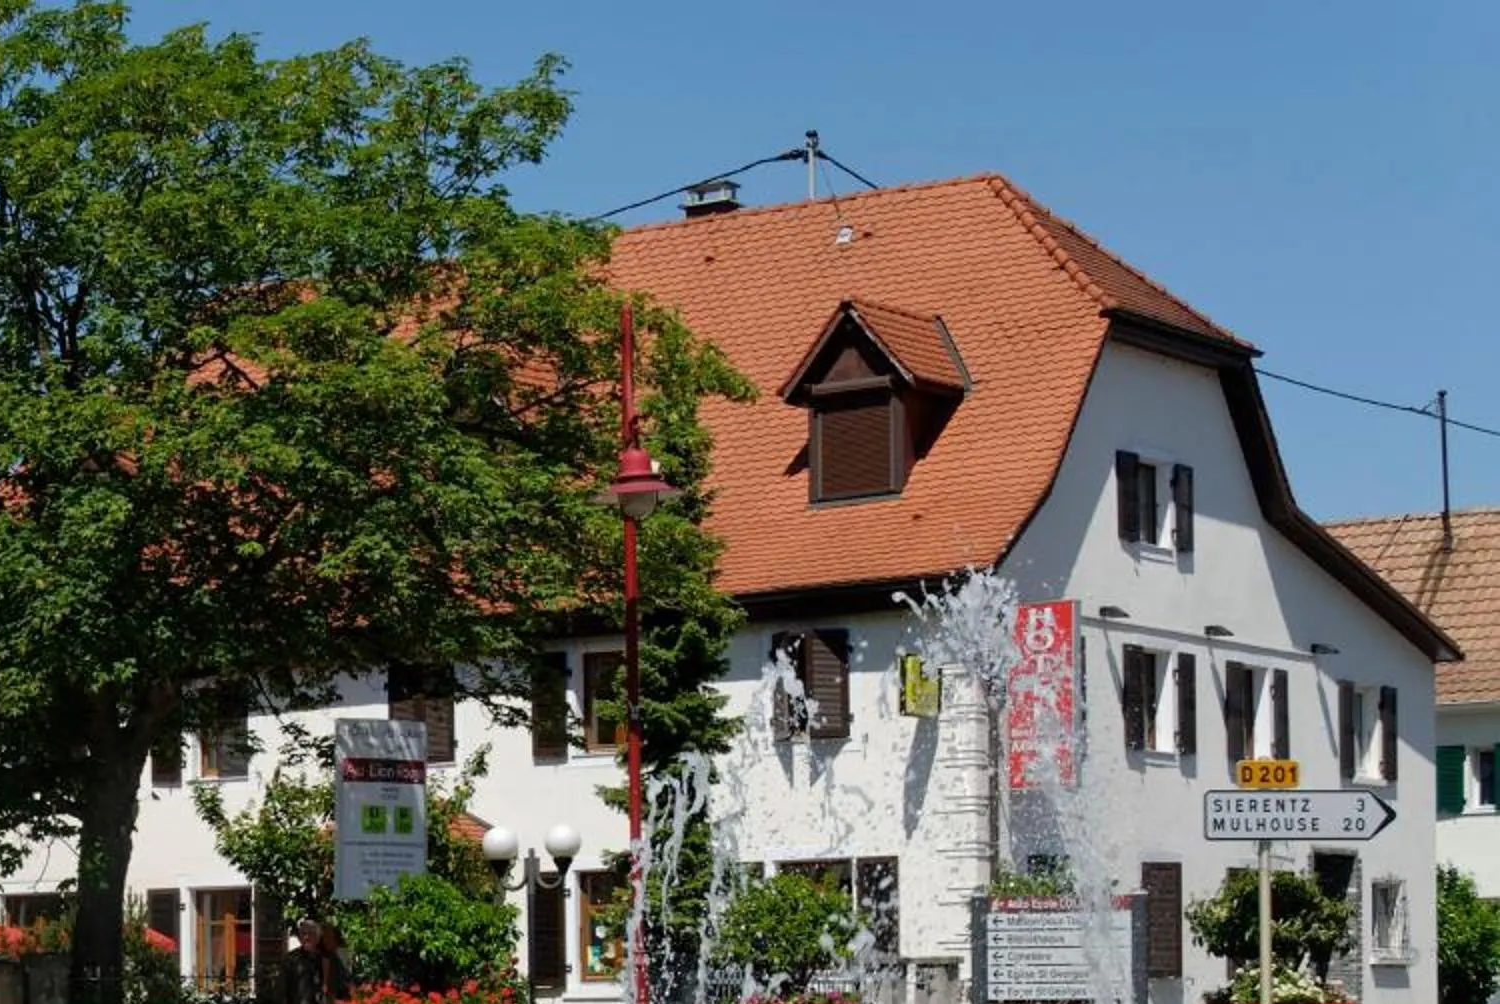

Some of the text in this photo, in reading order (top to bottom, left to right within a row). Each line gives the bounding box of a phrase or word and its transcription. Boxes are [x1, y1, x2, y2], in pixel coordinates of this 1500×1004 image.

[1241, 766, 1298, 782] D 201
[1212, 798, 1366, 813] SIERENTZ 3
[1212, 817, 1366, 832] MULHOUSE 20
